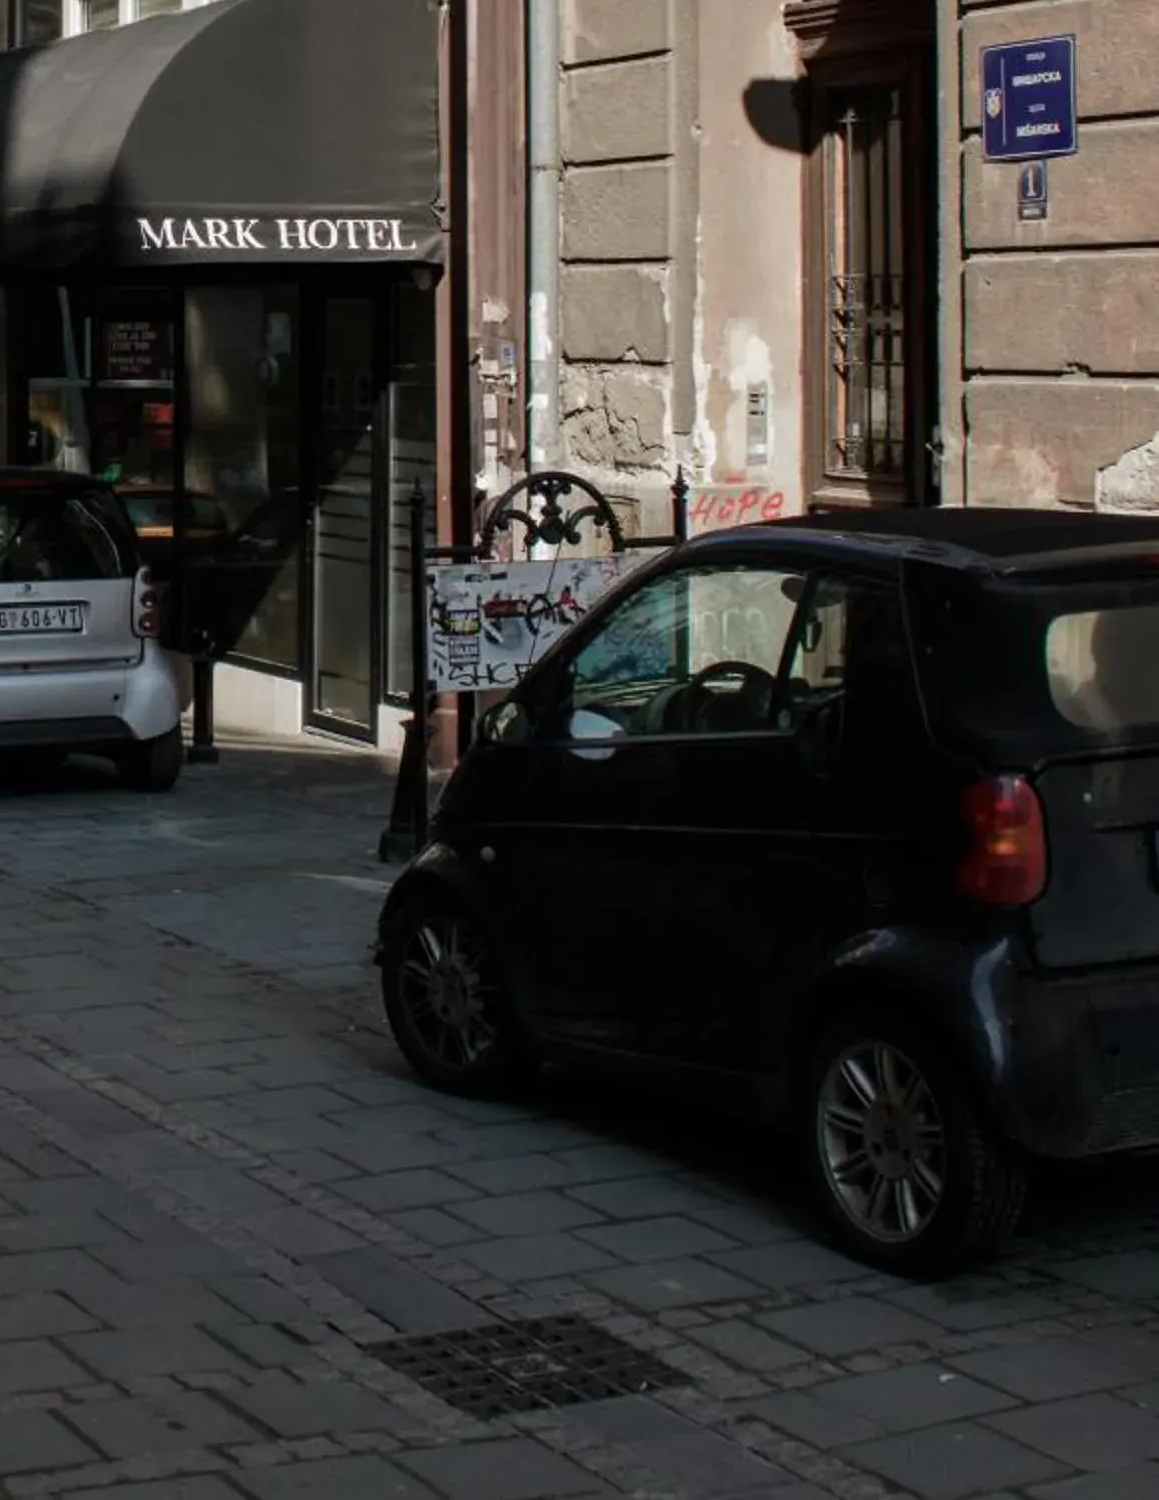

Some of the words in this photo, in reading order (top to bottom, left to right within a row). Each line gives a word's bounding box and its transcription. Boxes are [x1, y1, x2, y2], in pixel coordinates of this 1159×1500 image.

[137, 217, 266, 251] MARK
[277, 217, 417, 251] HOTEL
[20, 608, 78, 628] 606-VT
